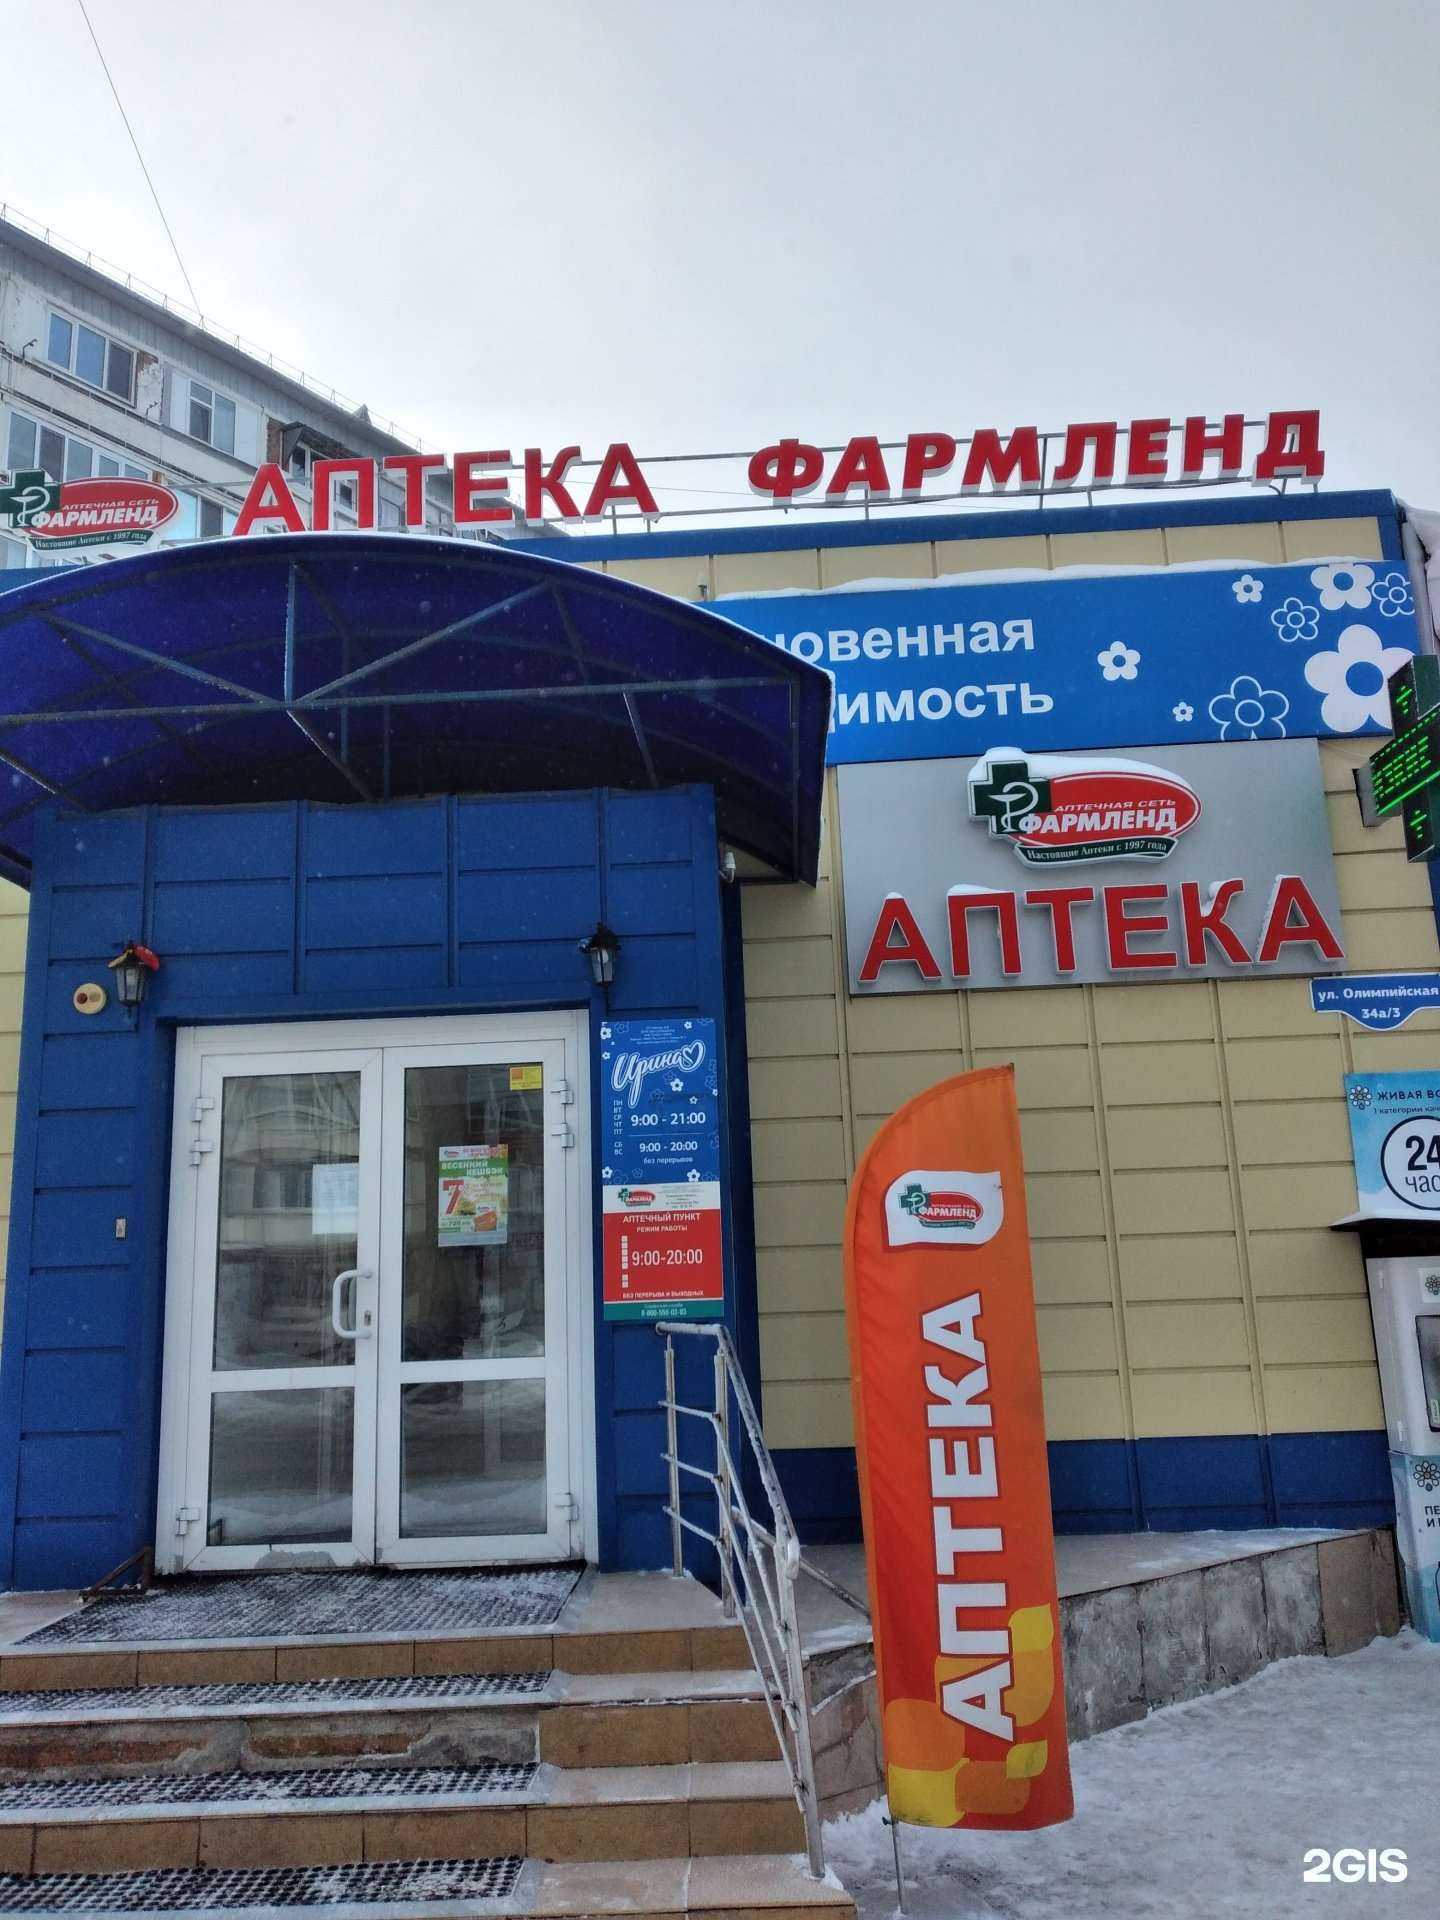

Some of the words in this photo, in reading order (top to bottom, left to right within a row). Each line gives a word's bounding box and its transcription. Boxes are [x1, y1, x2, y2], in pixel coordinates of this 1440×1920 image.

[232, 443, 659, 537] АПТЕКА
[748, 410, 1325, 506] ФАРМЛЕНД
[62, 500, 125, 511] АПТЕЧНАЯ
[128, 498, 160, 507] СЕТЬ
[31, 506, 158, 528] ФАРМЛЕНД
[113, 531, 131, 541] 1997
[828, 682, 1054, 733] имость
[1054, 801, 1133, 813] АПТЕЧНАЯ
[1137, 799, 1176, 808] СЕТЬ
[1019, 807, 1177, 834] ФАРМЛЕНД
[1027, 849, 1079, 860] Настоящие
[1081, 845, 1114, 856] Аптеки
[1124, 840, 1145, 851] 1997
[1147, 843, 1167, 852] года
[858, 875, 1346, 982] АПТЕКА
[1318, 989, 1339, 1003] ул.
[1343, 984, 1439, 999] Олимпийская
[1361, 1007, 1401, 1020] 34а/3
[1377, 1089, 1422, 1101] ЖИВАЯ
[630, 1114, 658, 1126] 9:00
[670, 1112, 706, 1125] 21:00
[640, 1142, 661, 1152] 9:00
[670, 1141, 698, 1151] 20:00
[1405, 1135, 1440, 1171] 24
[623, 1212, 671, 1223] АПТЕЧНЫЙ
[673, 1212, 701, 1221] ПУНКТ
[919, 1206, 976, 1219] ФАРМЛЕНД
[632, 1249, 703, 1266] 9:00-20:00
[922, 1291, 1013, 1742] АПТЕКА
